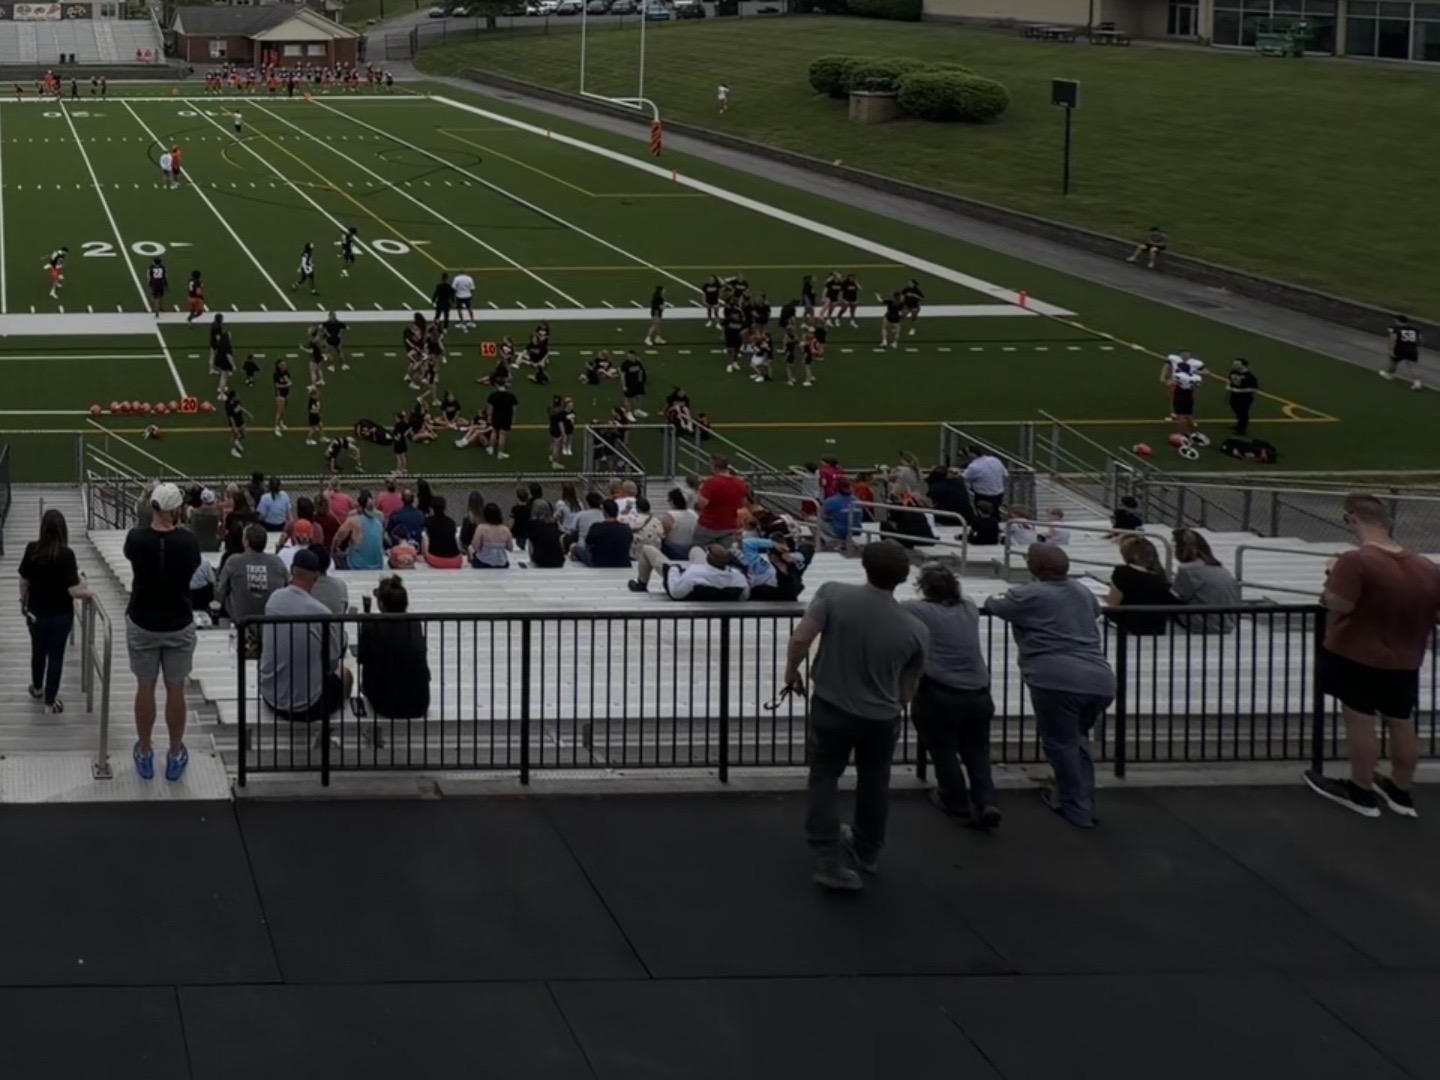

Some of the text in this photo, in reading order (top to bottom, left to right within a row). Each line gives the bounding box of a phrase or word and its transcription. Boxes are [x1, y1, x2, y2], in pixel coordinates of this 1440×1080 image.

[81, 241, 166, 258] 20
[482, 343, 496, 355] 10
[183, 398, 197, 411] 20
